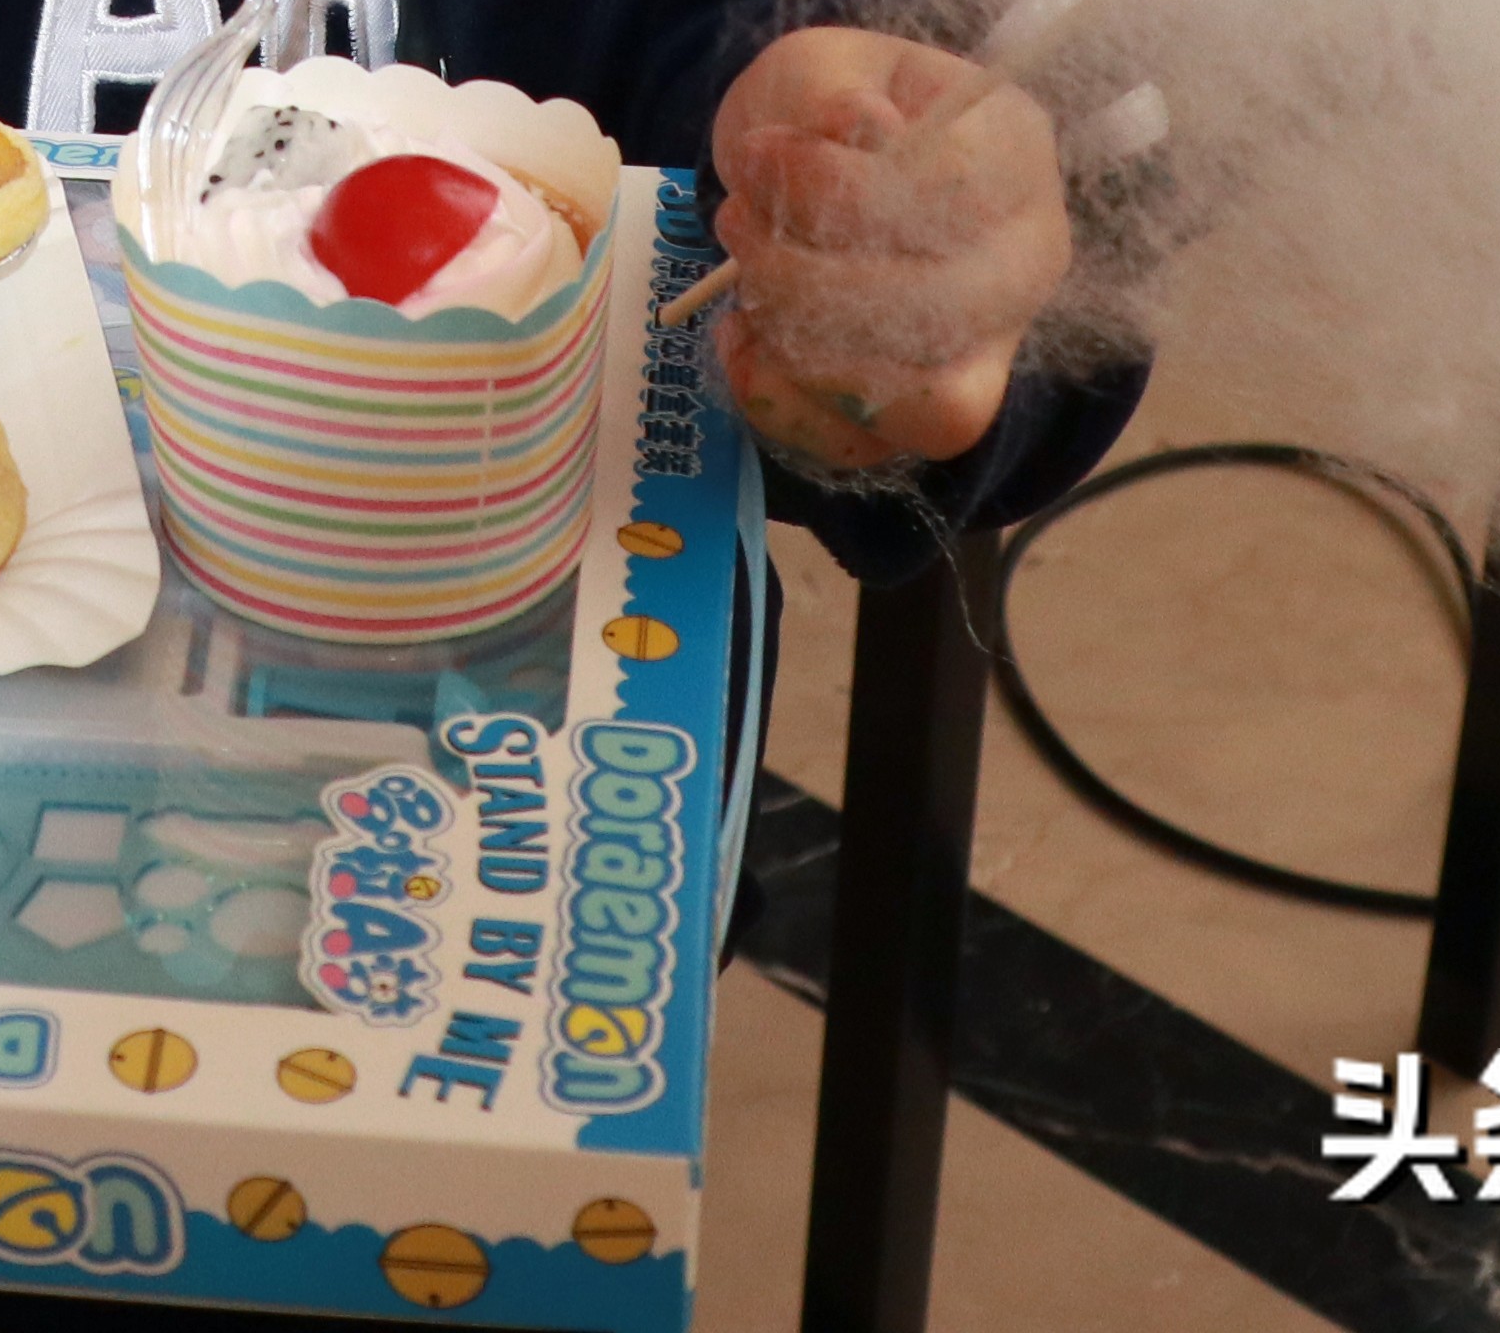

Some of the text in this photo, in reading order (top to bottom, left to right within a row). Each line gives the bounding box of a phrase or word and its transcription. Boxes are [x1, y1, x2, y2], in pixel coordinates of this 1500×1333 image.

[395, 715, 550, 1114] STAND BY ME
[549, 723, 690, 1113] Doraemon
